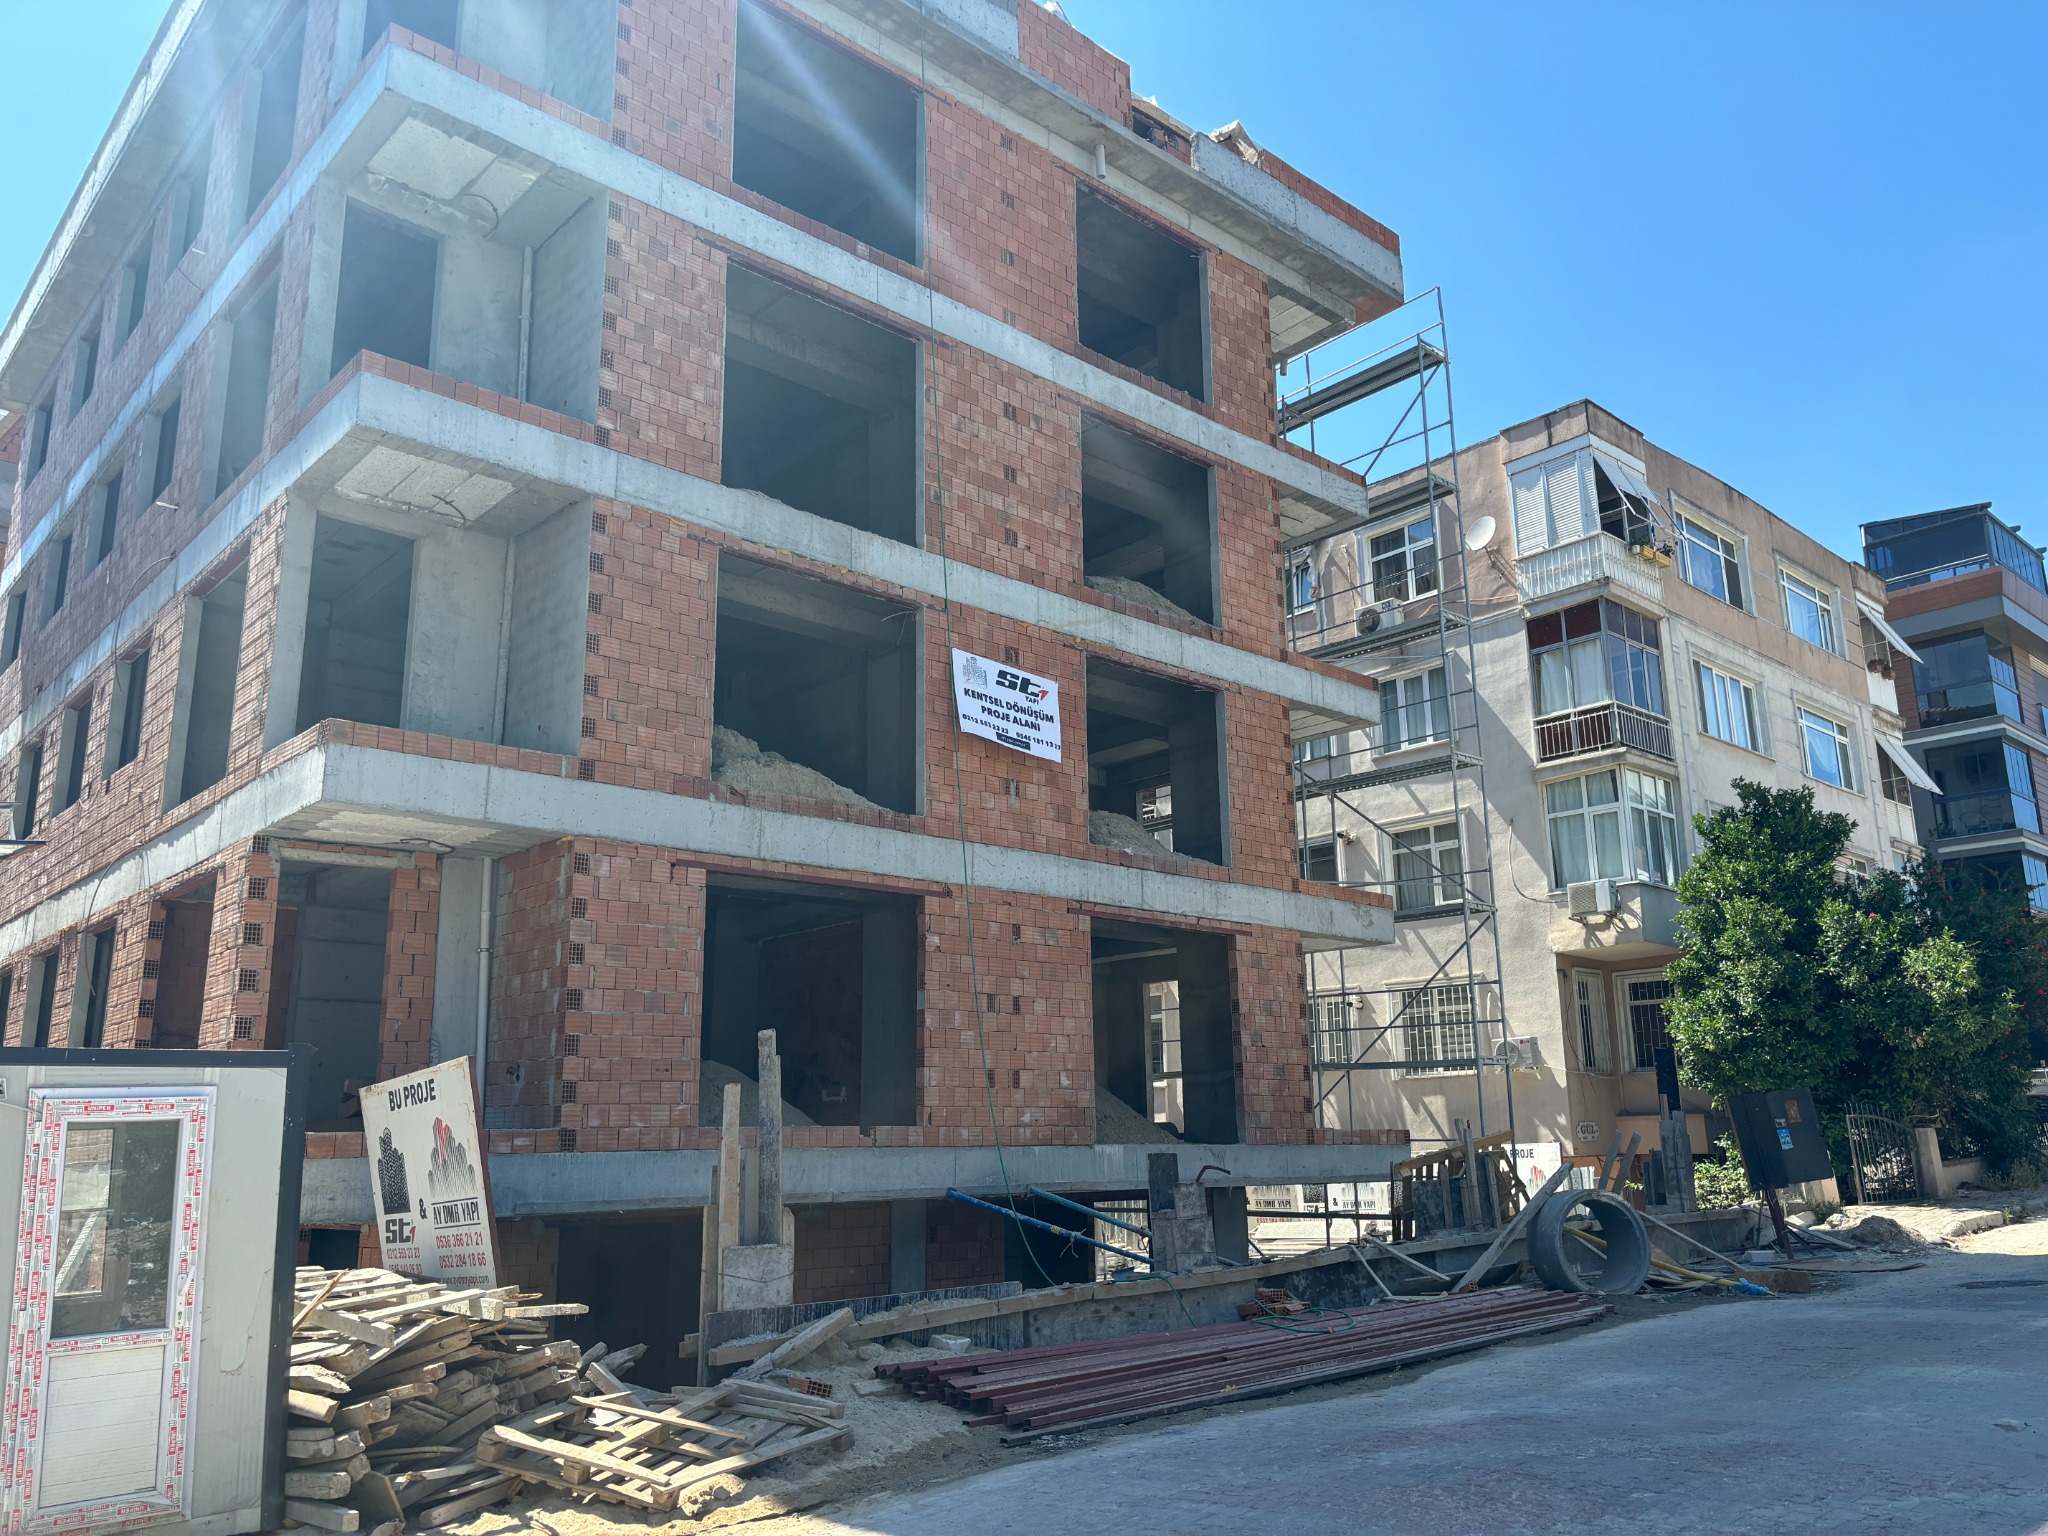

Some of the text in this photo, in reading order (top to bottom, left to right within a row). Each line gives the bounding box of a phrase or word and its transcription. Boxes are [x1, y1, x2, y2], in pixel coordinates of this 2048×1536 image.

[964, 688, 1054, 724] KENTSEL DÖNÜŞÜM
[962, 714, 978, 724] 0212
[981, 705, 1040, 732] PROJE ALANI
[388, 1078, 436, 1112] BU PROJE
[419, 1198, 428, 1219] &
[461, 1201, 480, 1222] YAPI
[436, 1234, 451, 1249] 0536
[465, 1232, 473, 1246] 21
[475, 1231, 483, 1245] 21
[439, 1252, 486, 1268] 0532 284 18 66
[39, 1295, 47, 1318] UNIPEN
[26, 1332, 34, 1356] UNIPEN
[16, 1452, 24, 1475] UNIPEN
[121, 1505, 144, 1514] UNIPEN
